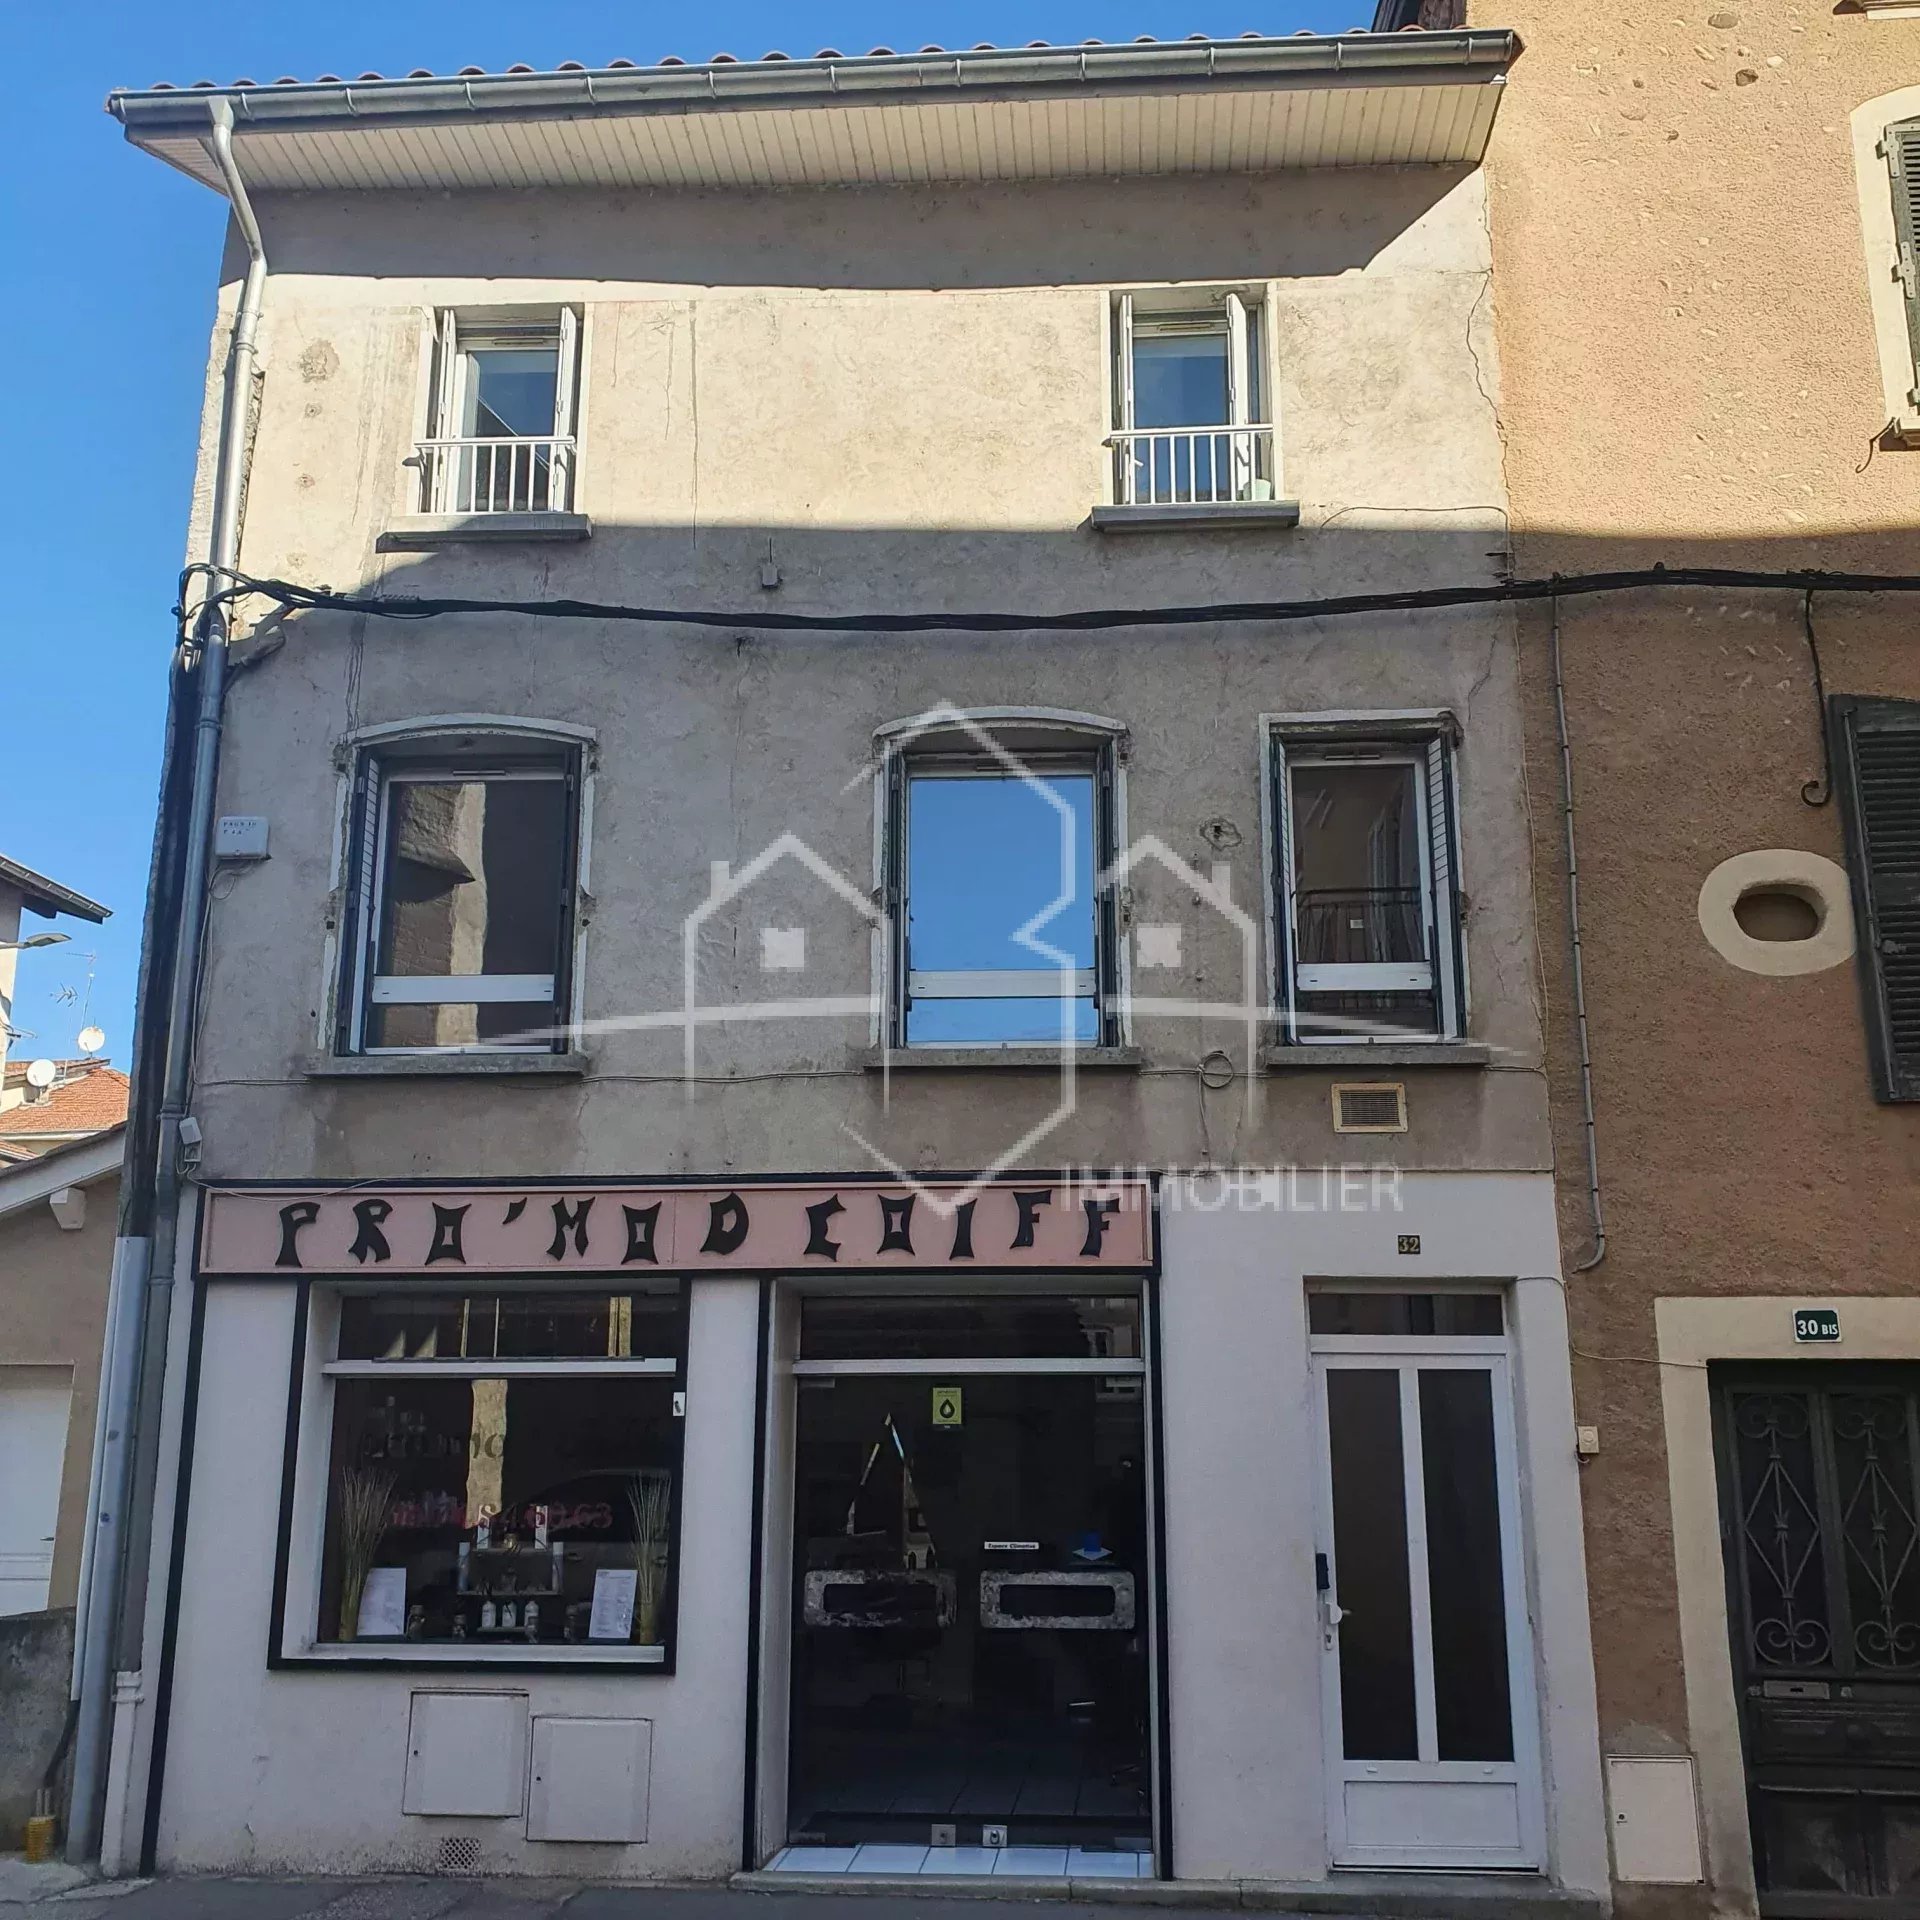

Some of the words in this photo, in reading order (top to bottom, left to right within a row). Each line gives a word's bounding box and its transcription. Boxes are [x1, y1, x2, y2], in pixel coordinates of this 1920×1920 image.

[1399, 1236, 1419, 1252] 32
[1797, 1319, 1818, 1335] 30
[1821, 1323, 1838, 1335] BIS
